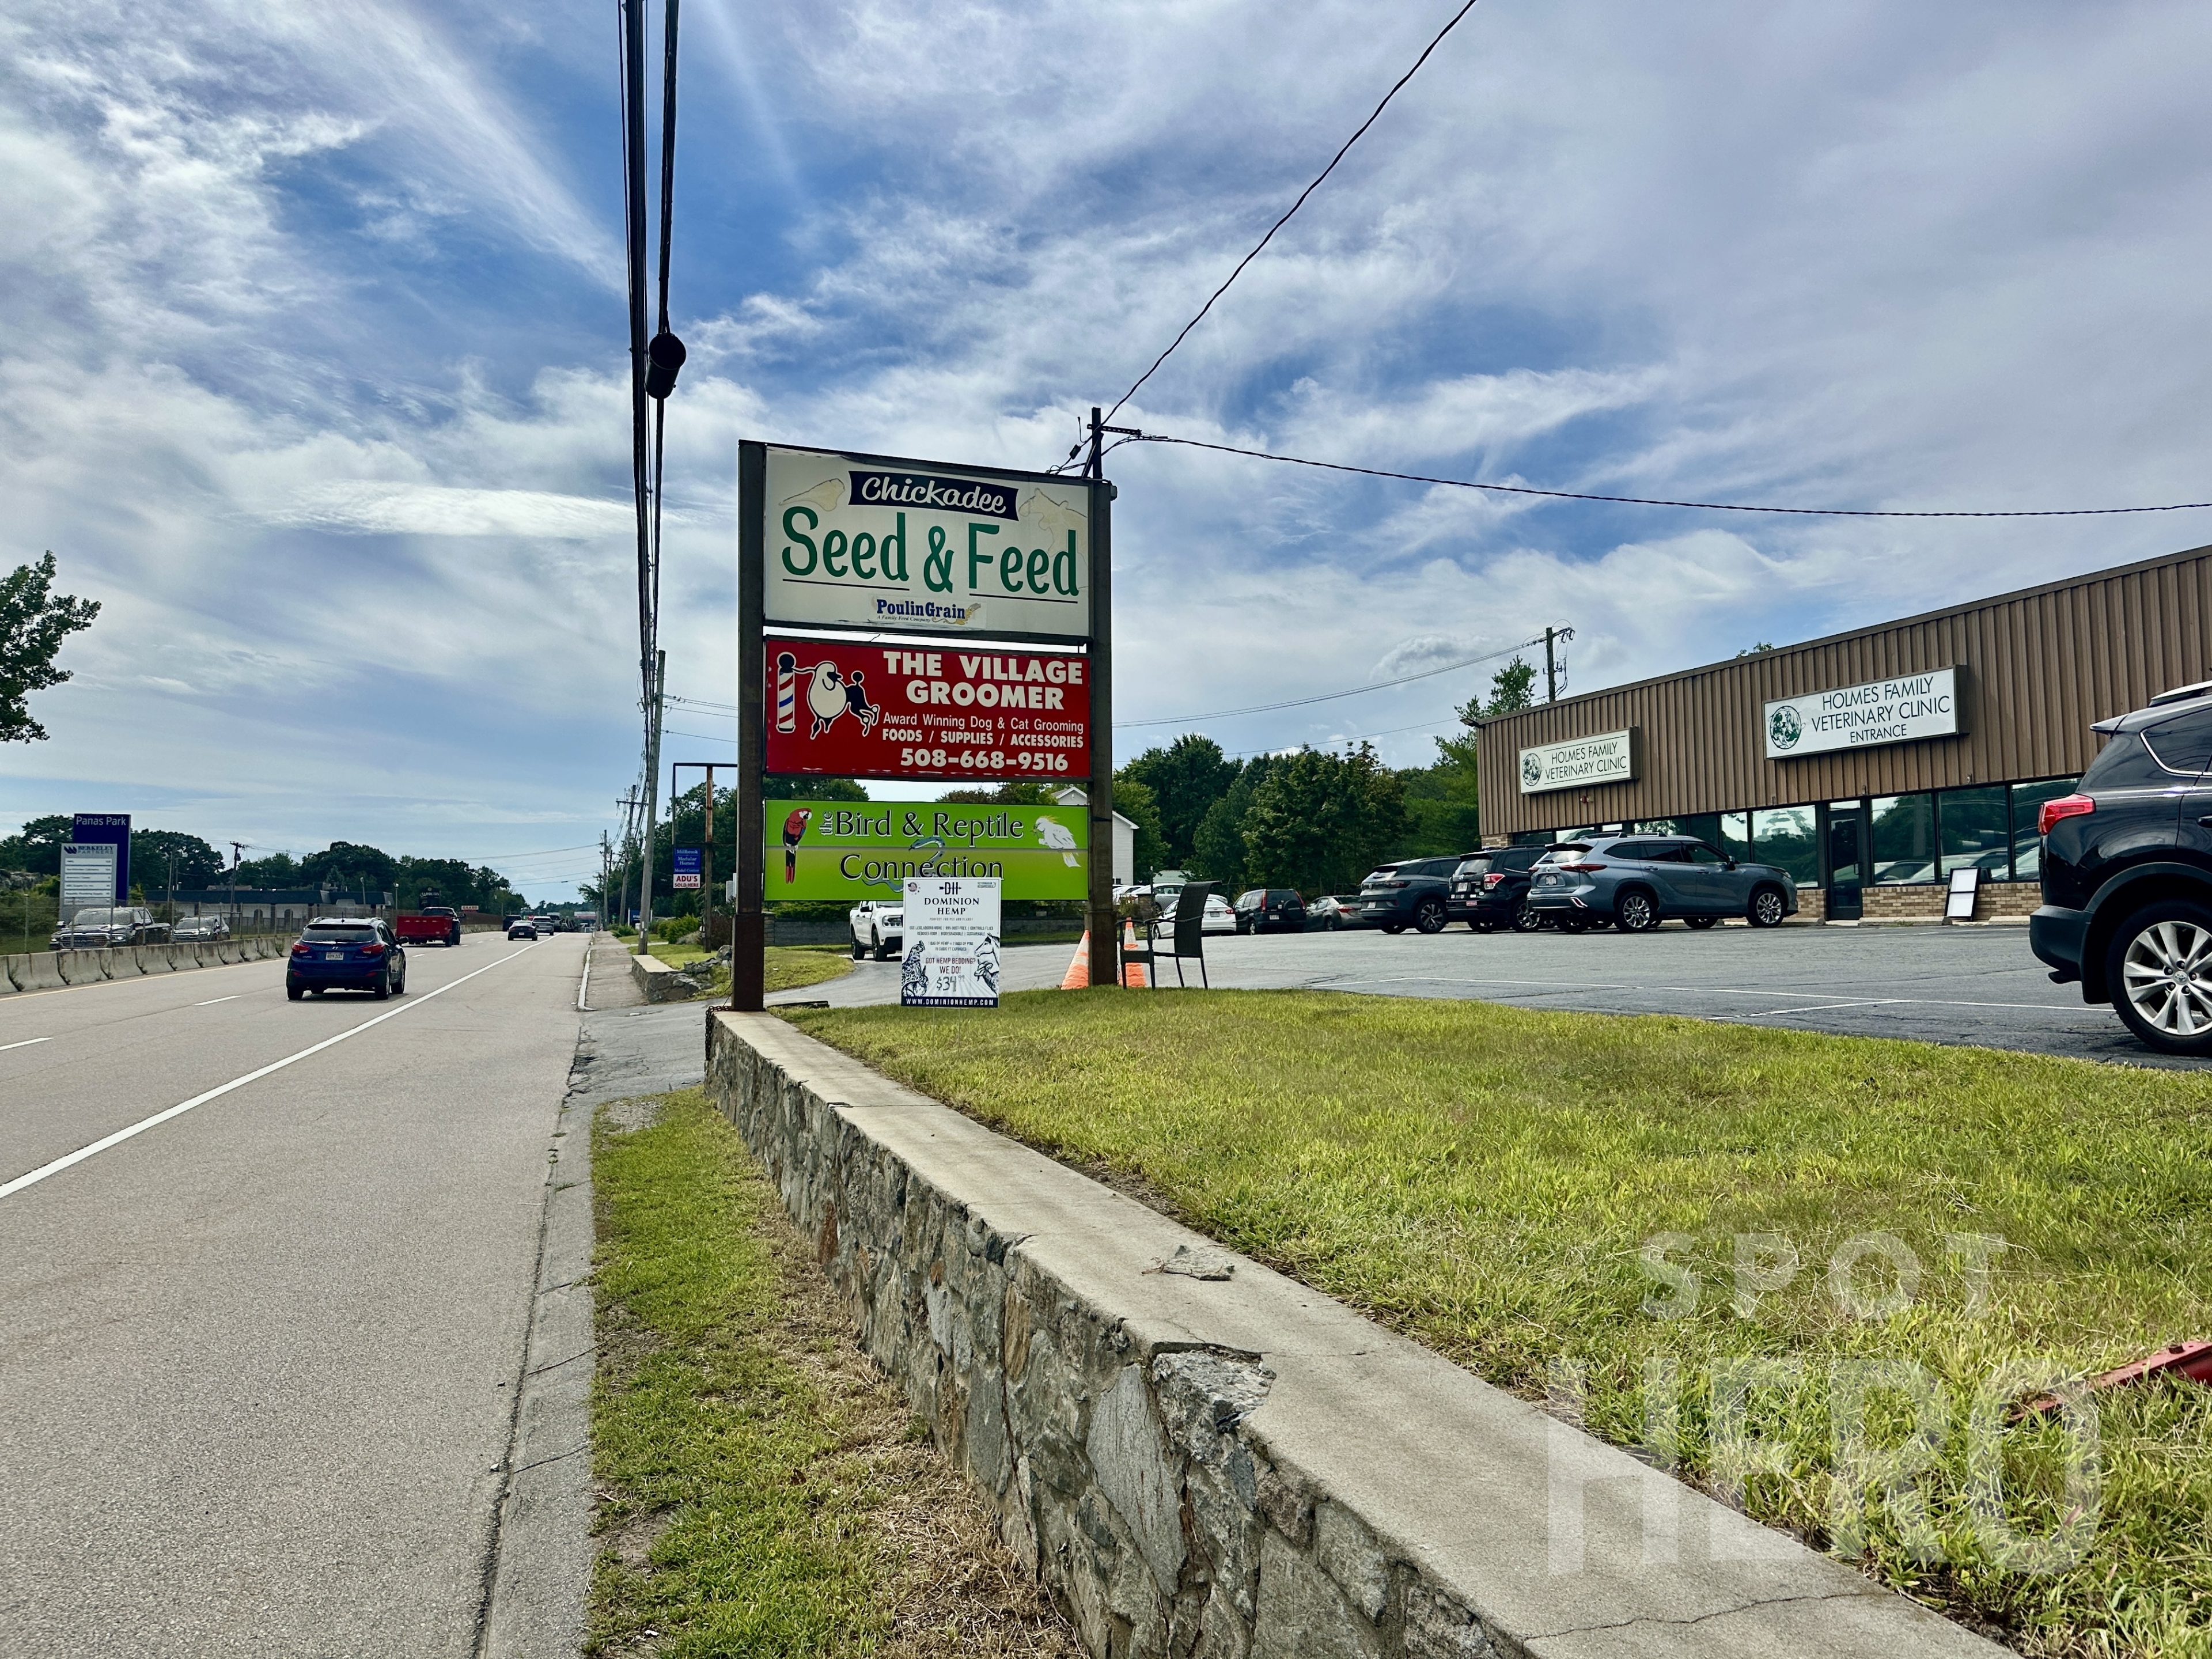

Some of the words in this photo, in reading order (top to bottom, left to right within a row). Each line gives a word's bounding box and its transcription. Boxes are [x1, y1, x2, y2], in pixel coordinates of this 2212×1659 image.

[861, 477, 1006, 514] Chickadee
[782, 506, 910, 581] Seed
[923, 525, 953, 593] &
[968, 522, 1080, 596] Feed
[883, 652, 942, 676] THE
[959, 656, 1083, 684] VILLAGE
[906, 680, 1064, 710] GROOMER
[1823, 686, 1879, 711] HOLMES
[1884, 676, 1933, 700] FAMILY
[883, 712, 917, 725] Award
[922, 713, 965, 730] Winning
[970, 716, 992, 731] Dog
[997, 717, 1005, 729] &
[1010, 718, 1029, 730] Cat
[1033, 719, 1084, 734] Grooming
[1812, 704, 1894, 732] VETERINARY
[1899, 695, 1950, 719] CLINIC
[882, 729, 923, 743] FOODS
[941, 731, 994, 745] SUPPLIES
[1010, 733, 1084, 748] ACCESSORIES
[1850, 724, 1907, 743] ENTRANCE
[900, 749, 1069, 771] 508-668-9516
[1552, 747, 1586, 764] HOLMES
[1588, 741, 1618, 758] FAMILY
[1546, 761, 1594, 780] VETERINARY
[1597, 756, 1627, 772] CLINIC
[76, 816, 104, 825] Panas
[106, 816, 126, 825] Park
[819, 811, 834, 835] the
[835, 810, 892, 836] Bird
[902, 811, 924, 837] &
[933, 811, 1024, 848] Reptile
[840, 853, 1004, 880] Connection
[924, 897, 979, 906] DOMINION
[940, 965, 949, 974] WE
